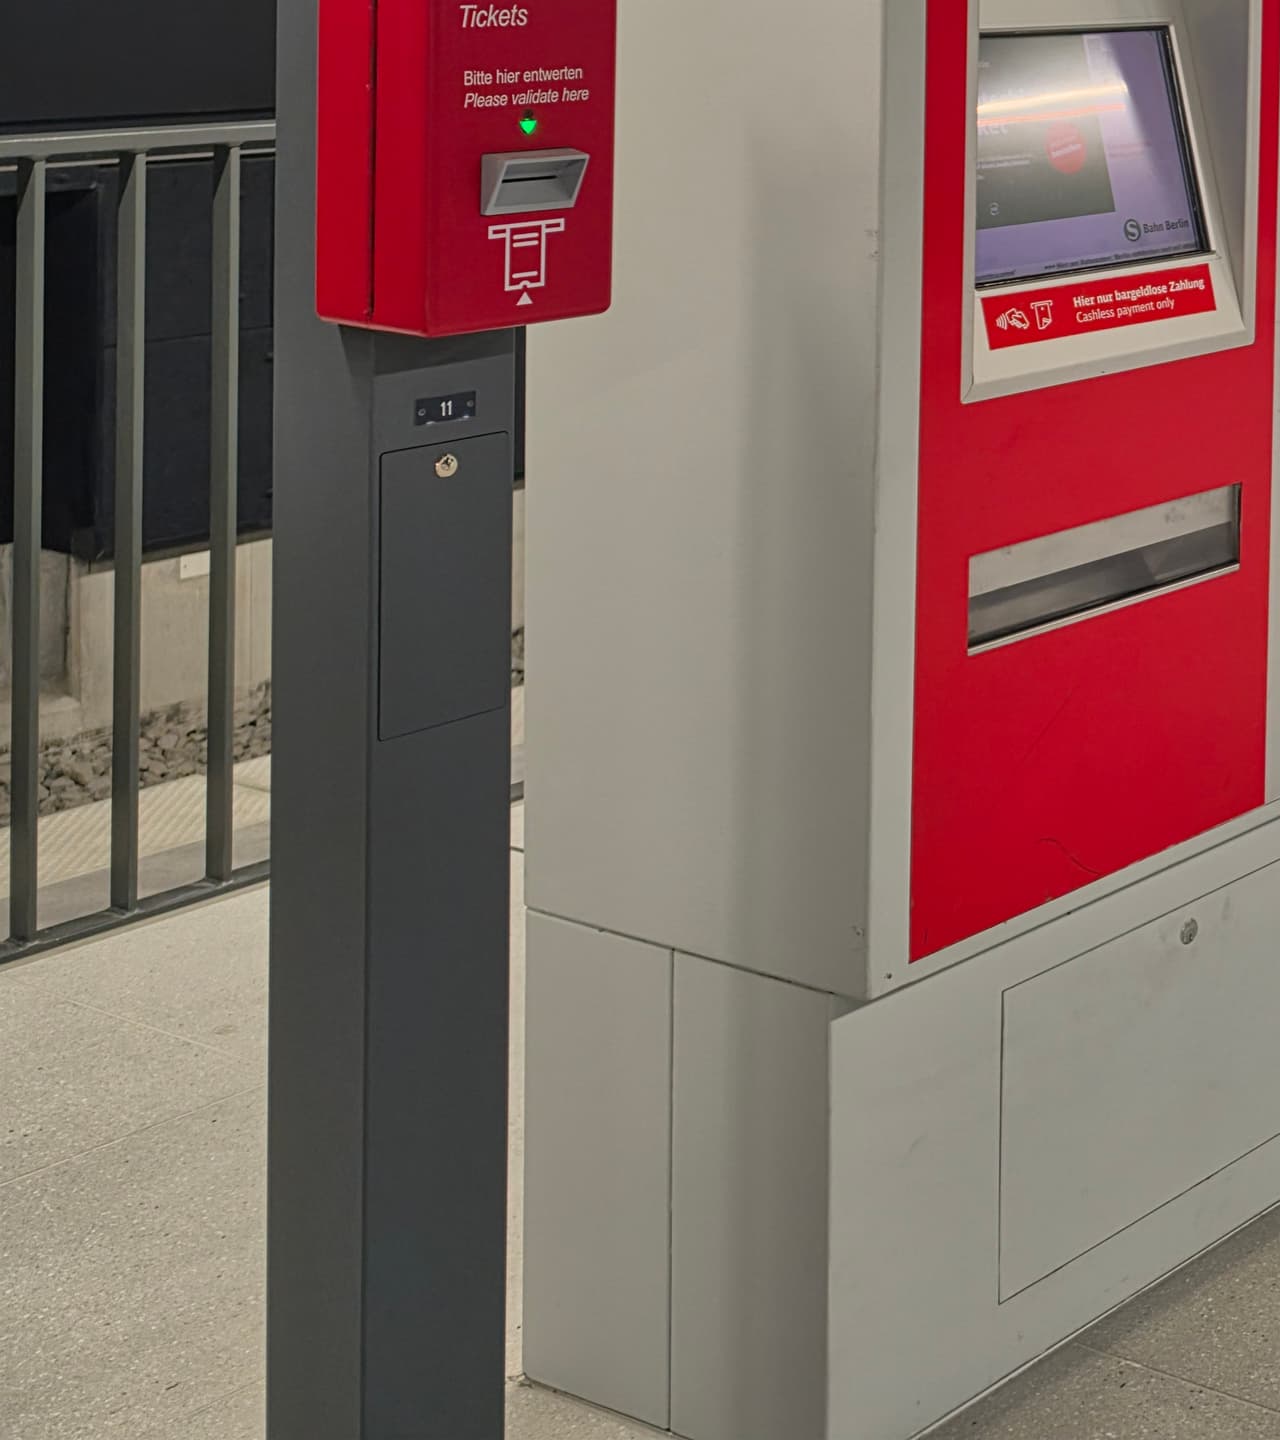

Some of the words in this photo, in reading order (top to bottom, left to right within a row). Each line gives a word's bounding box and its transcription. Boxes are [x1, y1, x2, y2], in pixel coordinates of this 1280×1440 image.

[459, 4, 529, 28] Tickets
[463, 70, 493, 86] Bitte
[496, 69, 520, 84] hier
[523, 66, 583, 83] entwerten
[463, 93, 508, 108] Please
[511, 88, 559, 104] validate
[562, 87, 589, 102] here
[1143, 221, 1163, 234] Bahn
[1165, 218, 1189, 231] Berlin
[1073, 296, 1095, 308] Hier
[1097, 294, 1113, 304] nur
[1115, 285, 1167, 301] bargeldlose
[1168, 279, 1205, 292] Zahlung
[1076, 308, 1115, 323] Cashless
[1116, 301, 1155, 318] payment
[1156, 297, 1175, 310] only
[440, 400, 453, 417] 11
